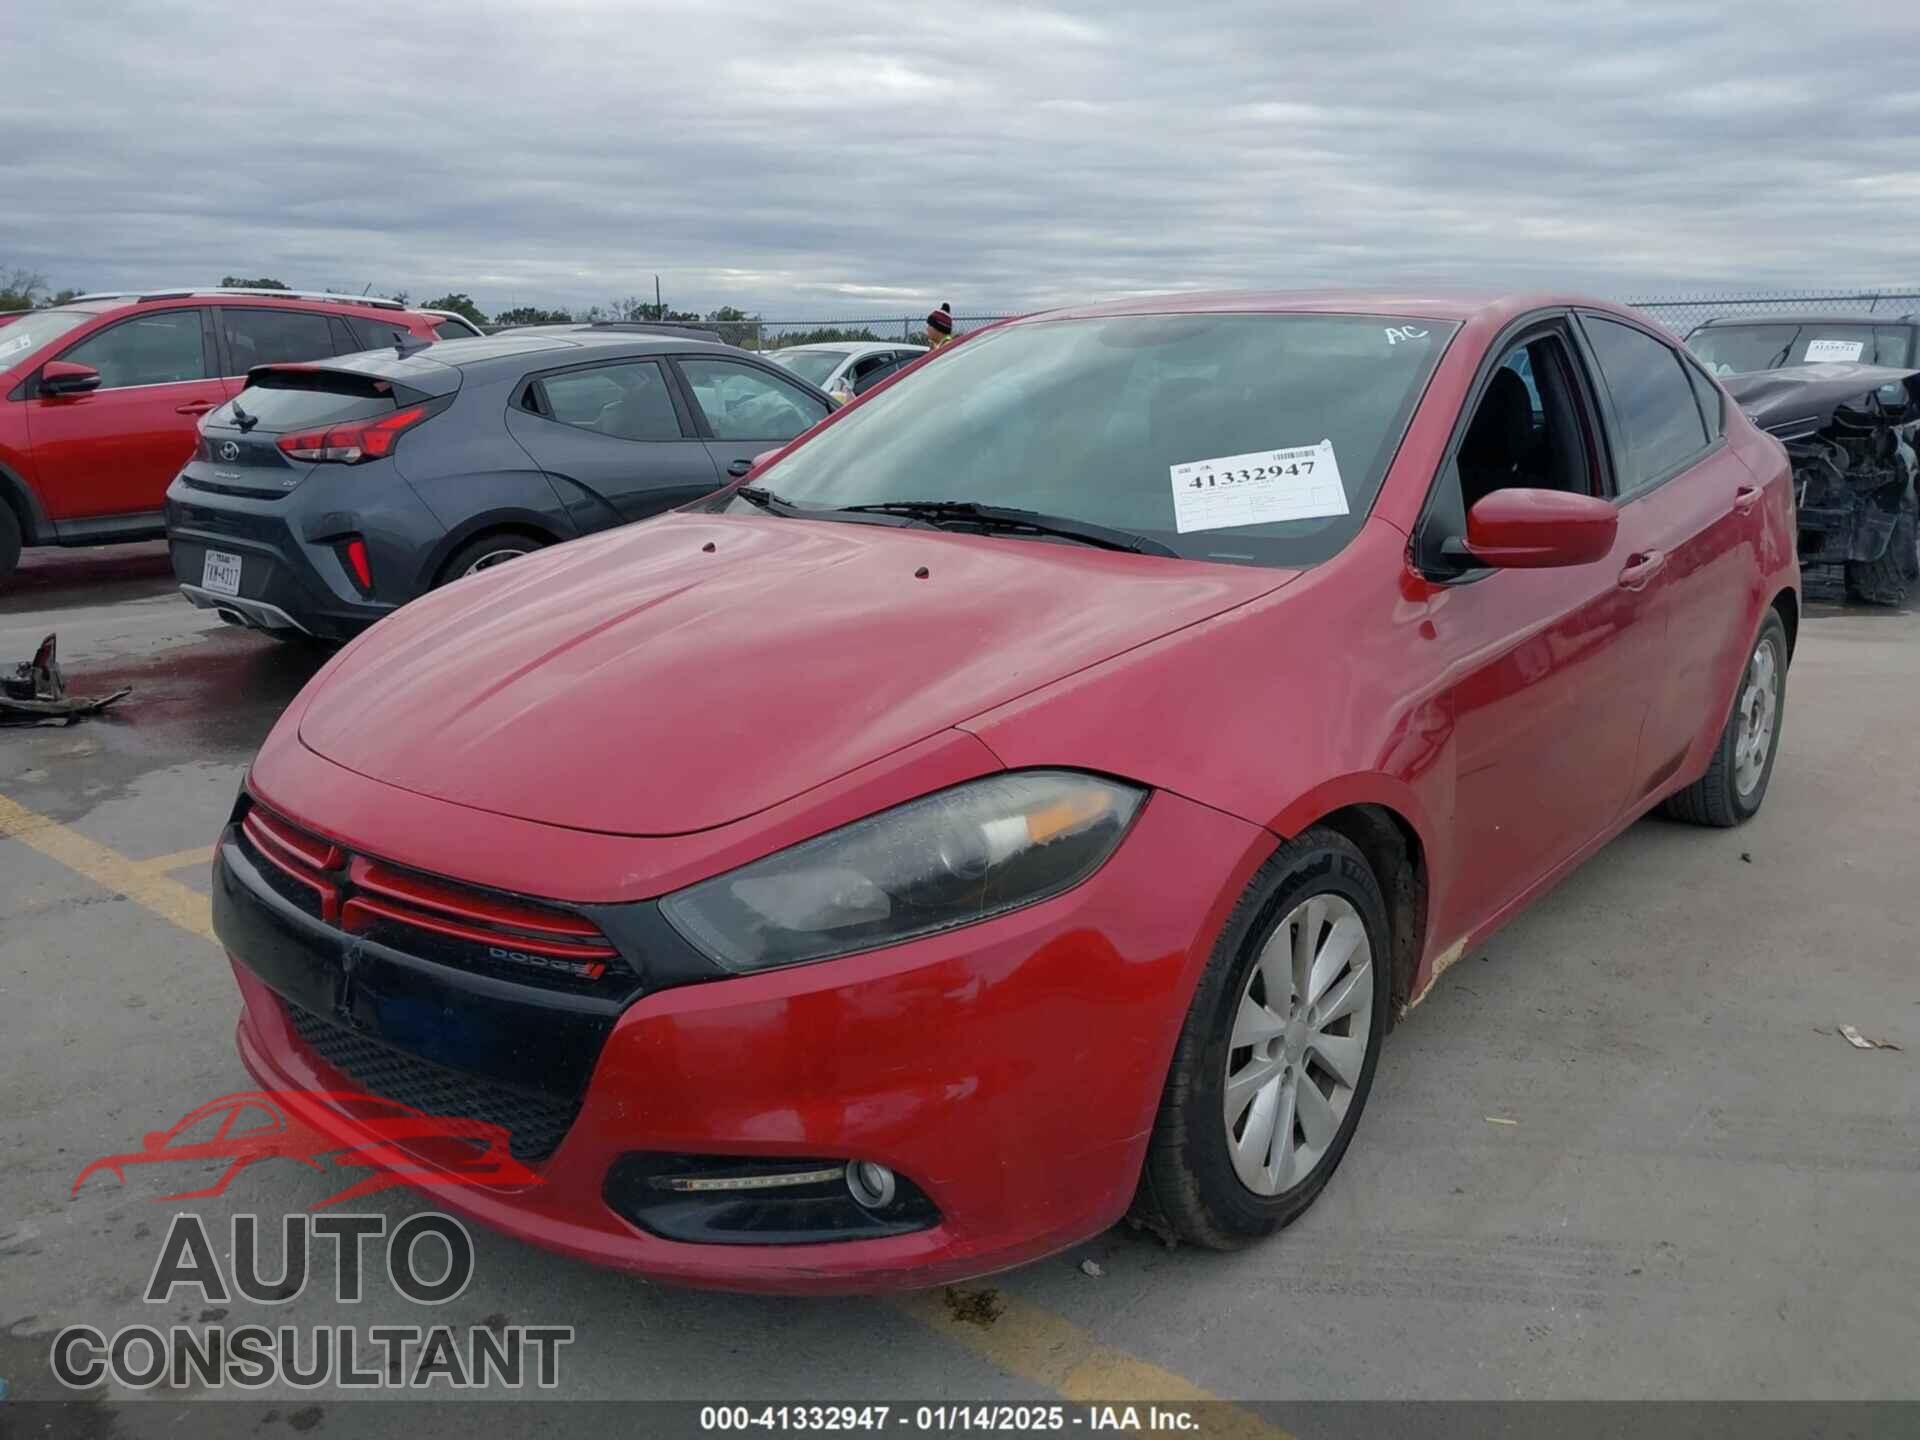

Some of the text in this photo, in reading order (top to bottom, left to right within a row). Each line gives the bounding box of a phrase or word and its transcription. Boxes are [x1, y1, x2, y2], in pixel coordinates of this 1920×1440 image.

[1384, 325, 1429, 344] AC
[1189, 461, 1315, 489] 41332947
[489, 947, 589, 977] DODGE
